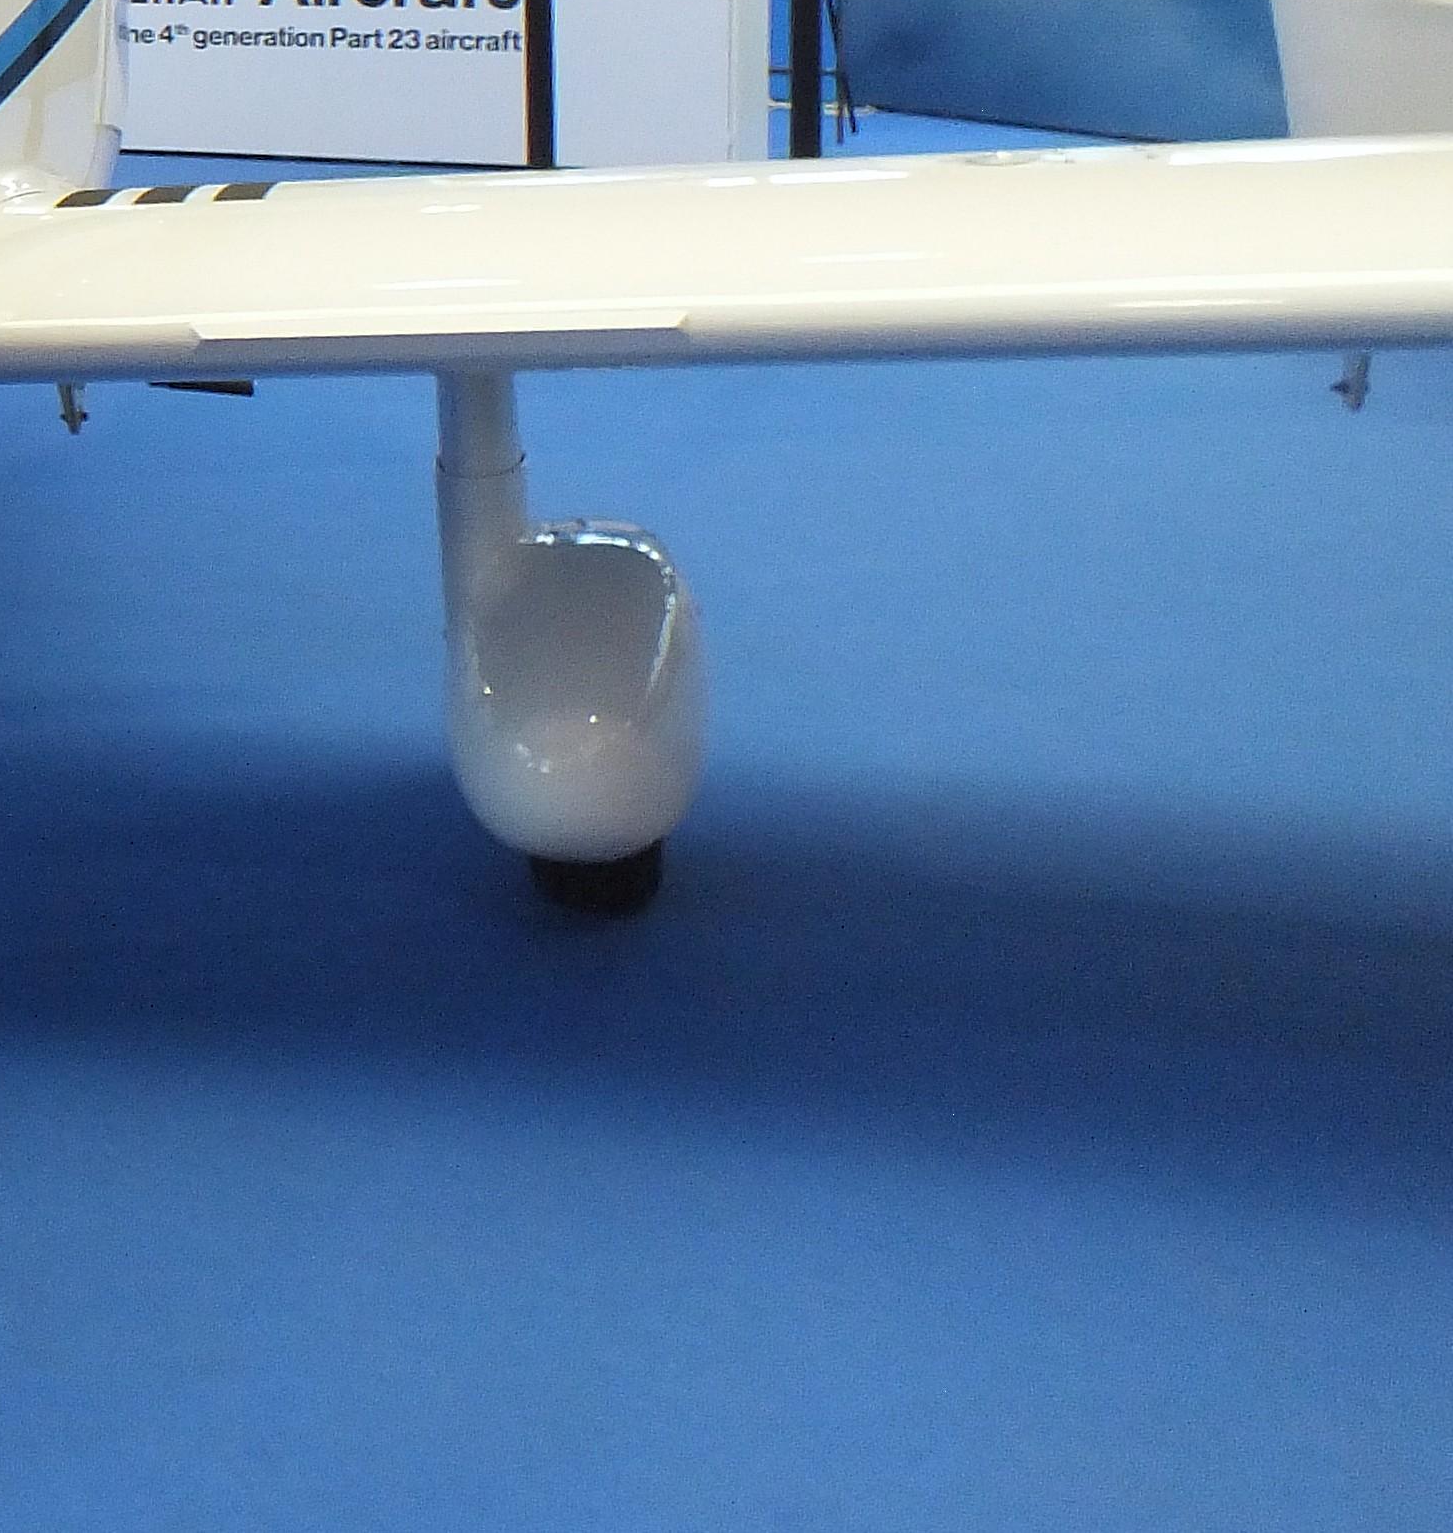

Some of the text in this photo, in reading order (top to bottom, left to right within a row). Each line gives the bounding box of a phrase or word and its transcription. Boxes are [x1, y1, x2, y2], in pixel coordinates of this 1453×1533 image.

[159, 22, 190, 44] 4th
[193, 27, 325, 49] generation
[330, 27, 384, 49] Part
[388, 28, 422, 50] 23
[425, 28, 522, 52] aircraft
